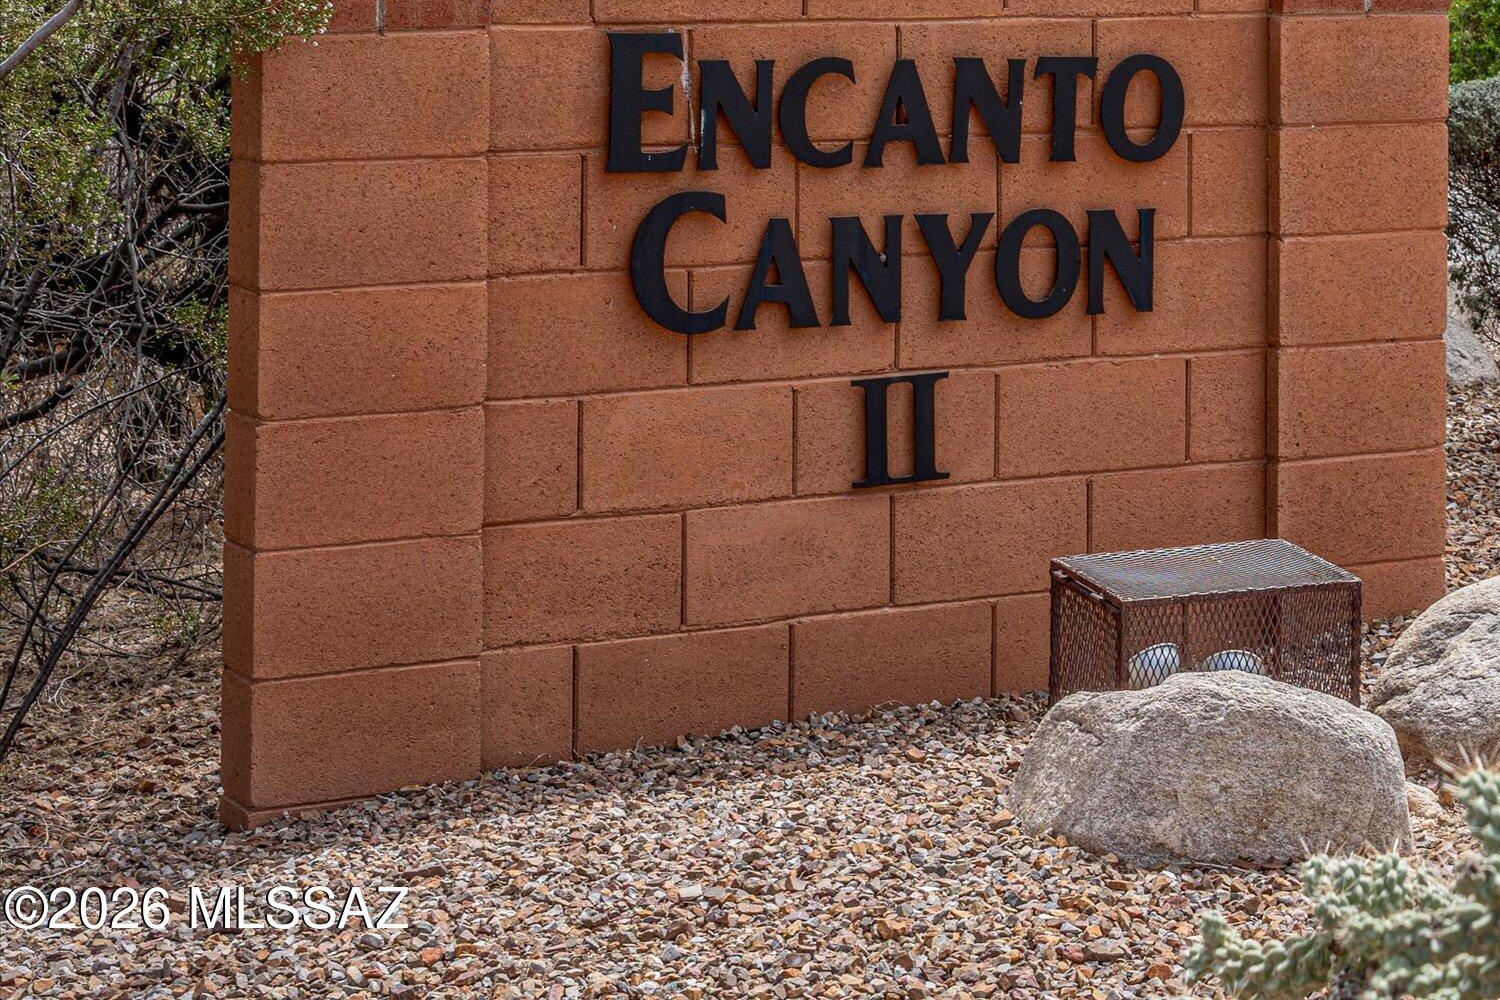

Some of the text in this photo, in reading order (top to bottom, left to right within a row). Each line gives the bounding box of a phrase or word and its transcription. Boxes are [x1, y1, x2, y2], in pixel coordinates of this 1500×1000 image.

[606, 32, 1185, 173] ENCANTO
[631, 191, 1156, 334] CANYON
[851, 372, 950, 489] II
